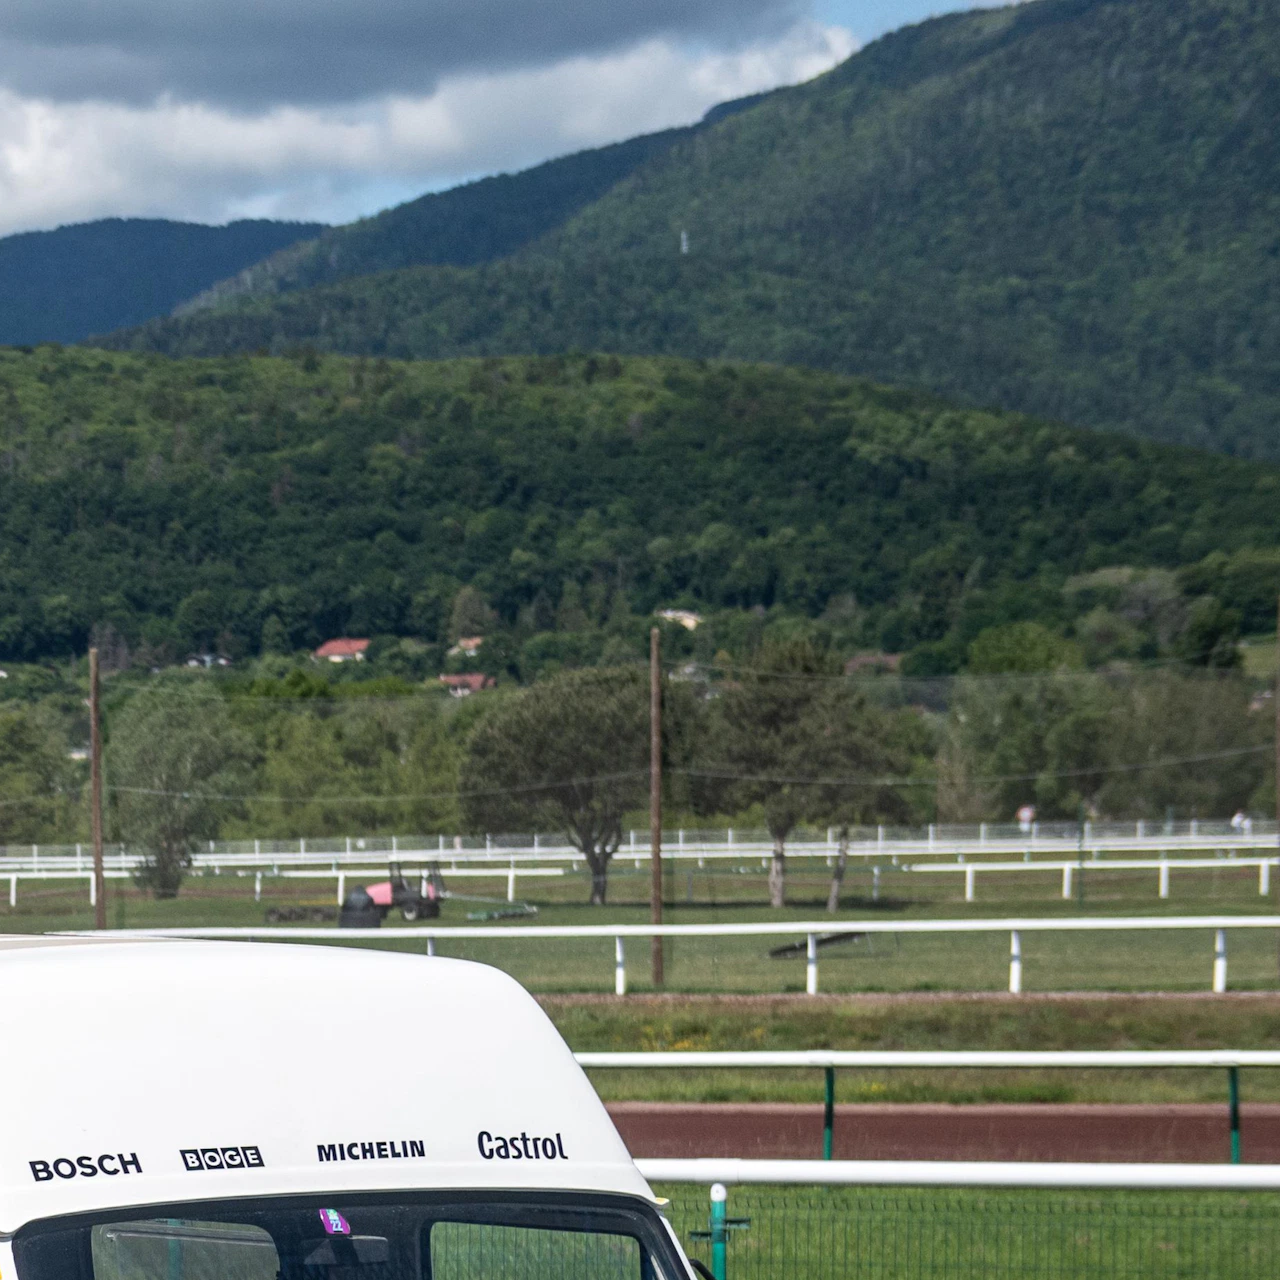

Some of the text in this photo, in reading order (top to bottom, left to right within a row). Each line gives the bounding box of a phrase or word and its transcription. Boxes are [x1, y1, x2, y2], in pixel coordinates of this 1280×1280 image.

[317, 1140, 426, 1162] MICHELIN
[477, 1130, 569, 1160] Castrol
[28, 1152, 143, 1182] BOSCH
[184, 1148, 261, 1169] BOGE
